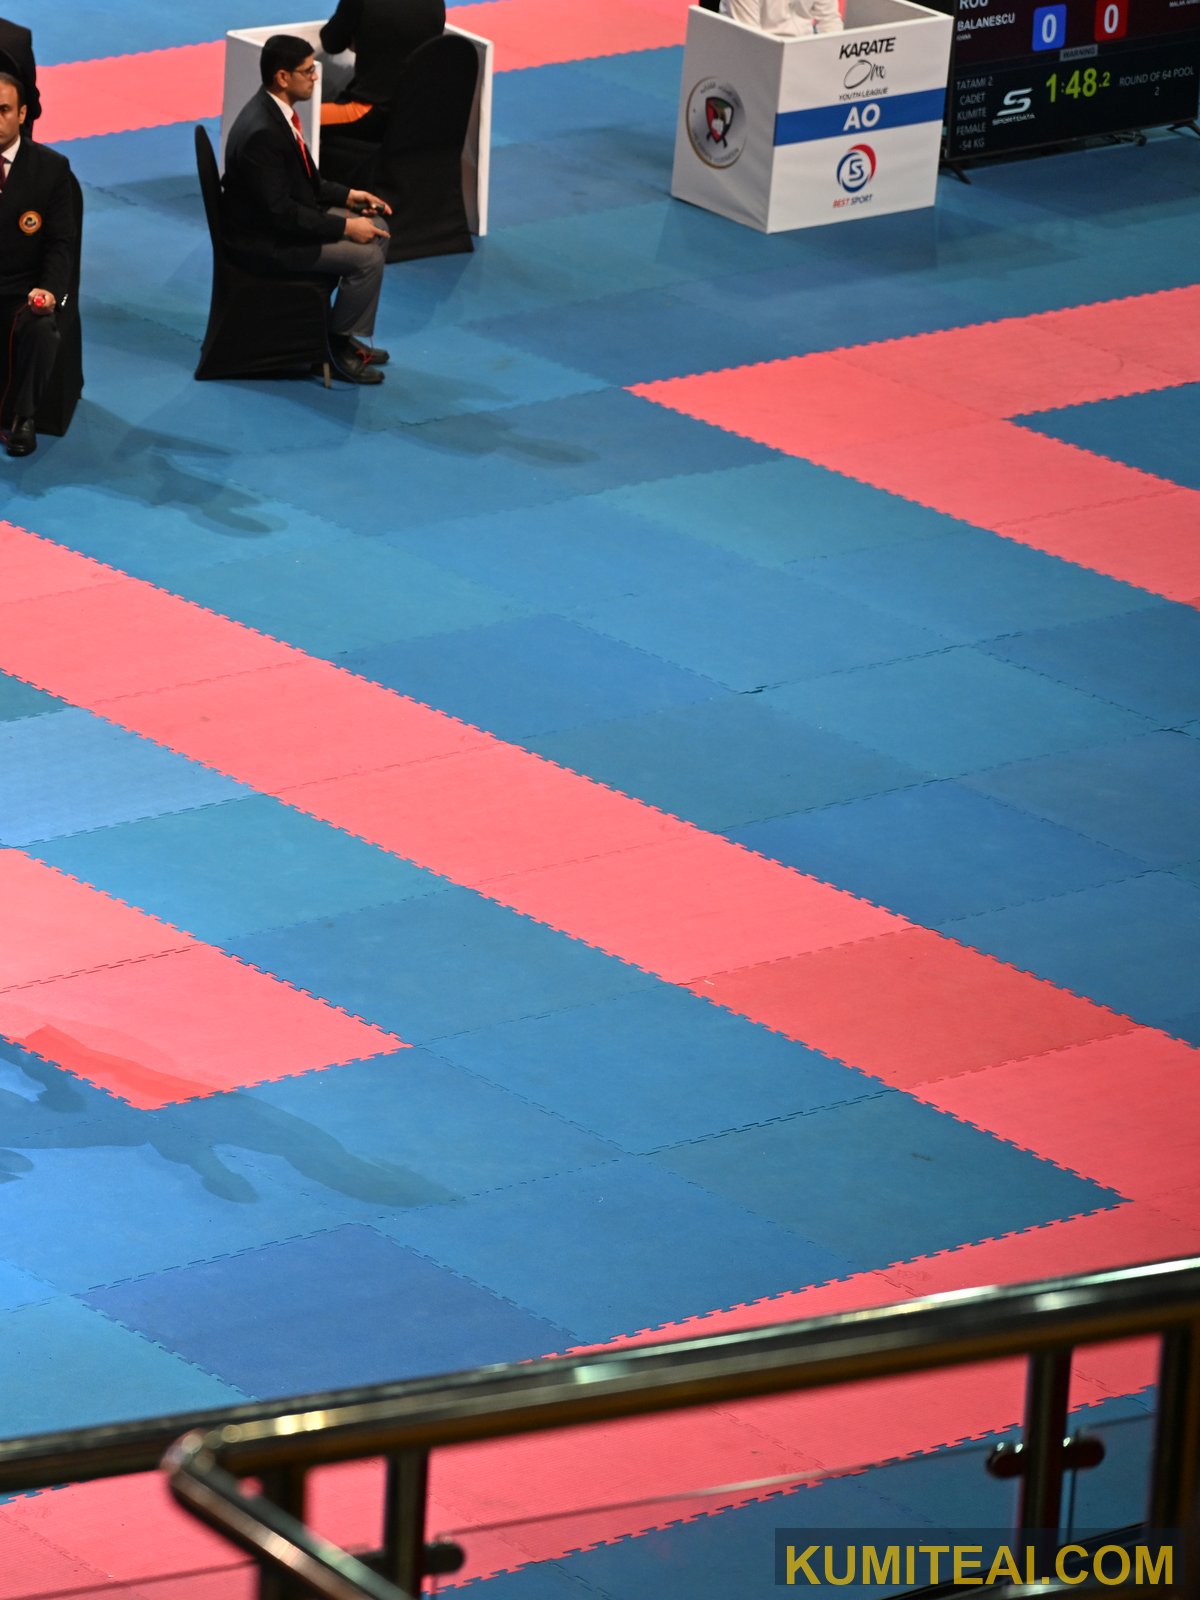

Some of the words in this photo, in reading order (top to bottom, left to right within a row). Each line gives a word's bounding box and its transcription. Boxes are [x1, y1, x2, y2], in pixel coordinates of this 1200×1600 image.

[957, 12, 1016, 32] BALANESCU
[1042, 13, 1057, 44] 0
[1103, 4, 1119, 34] 0
[839, 37, 897, 60] KARATE
[1063, 46, 1096, 58] WARNING
[844, 59, 887, 90] One
[1119, 74, 1149, 87] ROUND
[1150, 71, 1161, 82] OF
[1173, 66, 1194, 78] POOL
[960, 92, 986, 106] CADET
[843, 103, 881, 131] AO
[957, 107, 987, 121] KUMITE
[956, 122, 986, 136] FEMALE
